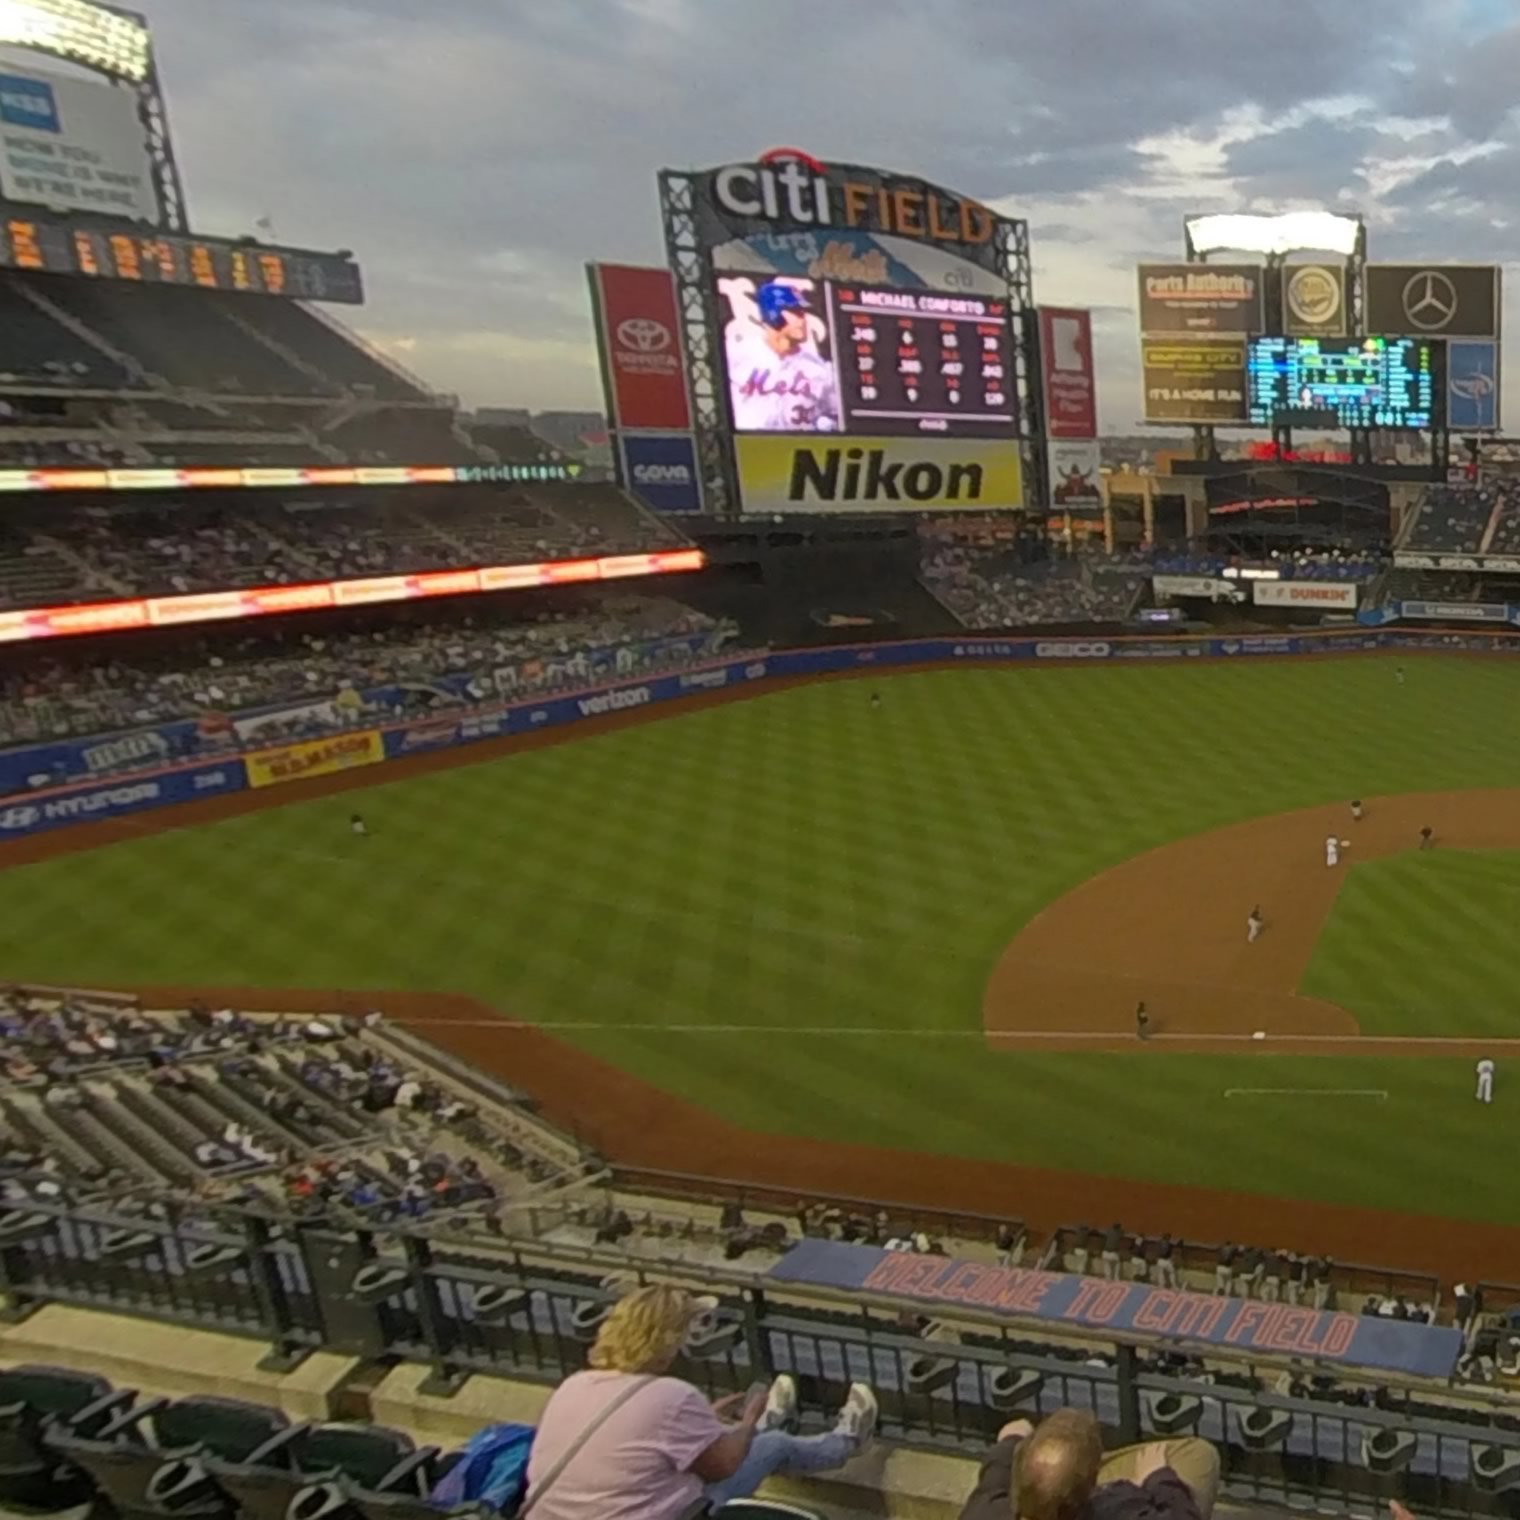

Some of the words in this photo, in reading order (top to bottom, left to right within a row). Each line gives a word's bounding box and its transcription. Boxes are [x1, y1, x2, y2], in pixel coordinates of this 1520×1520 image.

[715, 160, 832, 225] citi
[843, 182, 994, 243] FIELD
[860, 290, 916, 310] MICHAEL
[918, 295, 985, 316] CONFORTO
[615, 351, 678, 368] TOYOTA
[1182, 389, 1214, 401] HOME
[1217, 389, 1243, 401] RUN
[634, 463, 690, 482] GOYA
[789, 448, 983, 501] Nikon
[1035, 642, 1111, 658] GEICO
[577, 686, 651, 716] verizon
[44, 782, 160, 818] HYUNDAI
[862, 1248, 1059, 1314] WELCOME
[1064, 1277, 1129, 1320] TO
[1131, 1287, 1228, 1335] CITI
[1226, 1299, 1360, 1358] FIELD
